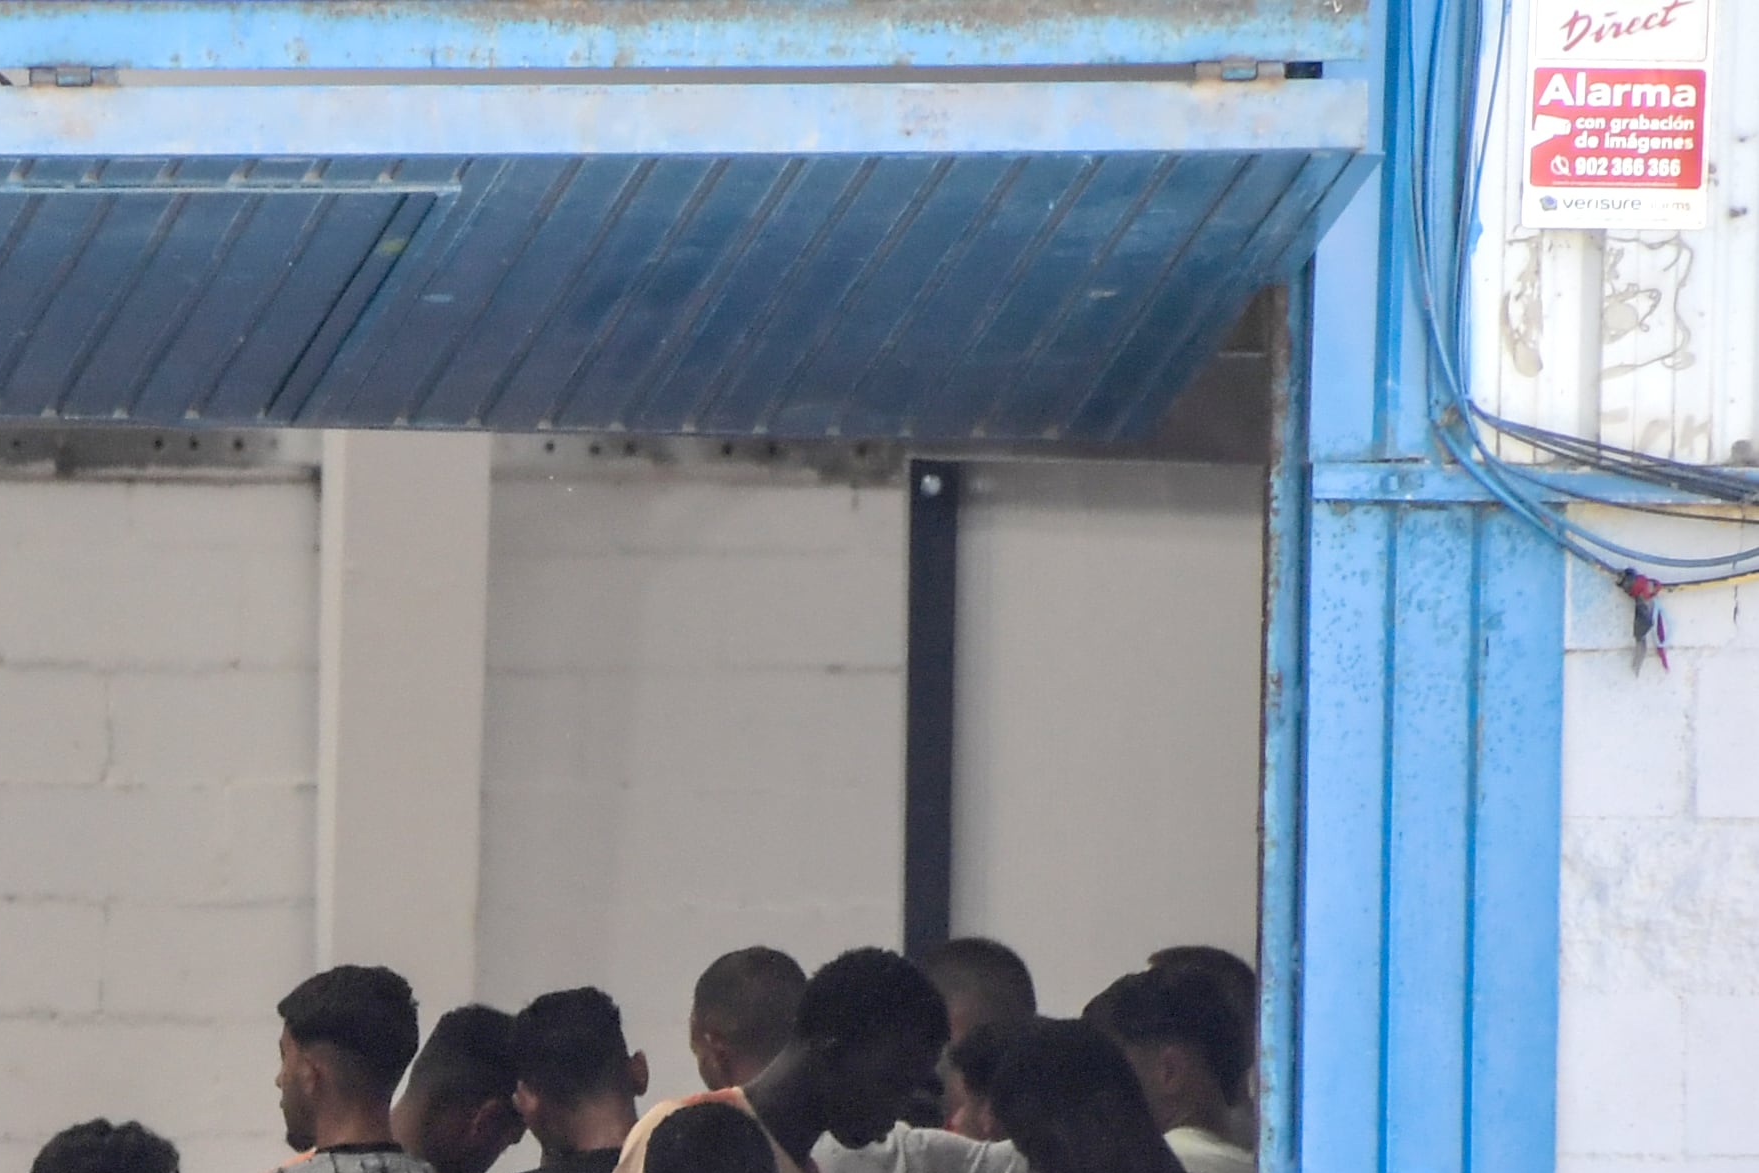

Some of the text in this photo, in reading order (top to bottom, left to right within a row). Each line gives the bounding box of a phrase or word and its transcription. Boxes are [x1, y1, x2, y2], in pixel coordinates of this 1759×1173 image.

[1559, 0, 1693, 52] Direct
[1538, 71, 1697, 108] Alarma
[1574, 114, 1695, 133] con grabación
[1574, 132, 1694, 154] de imágenes
[1574, 156, 1608, 176] 902
[1562, 196, 1642, 211] verisure
